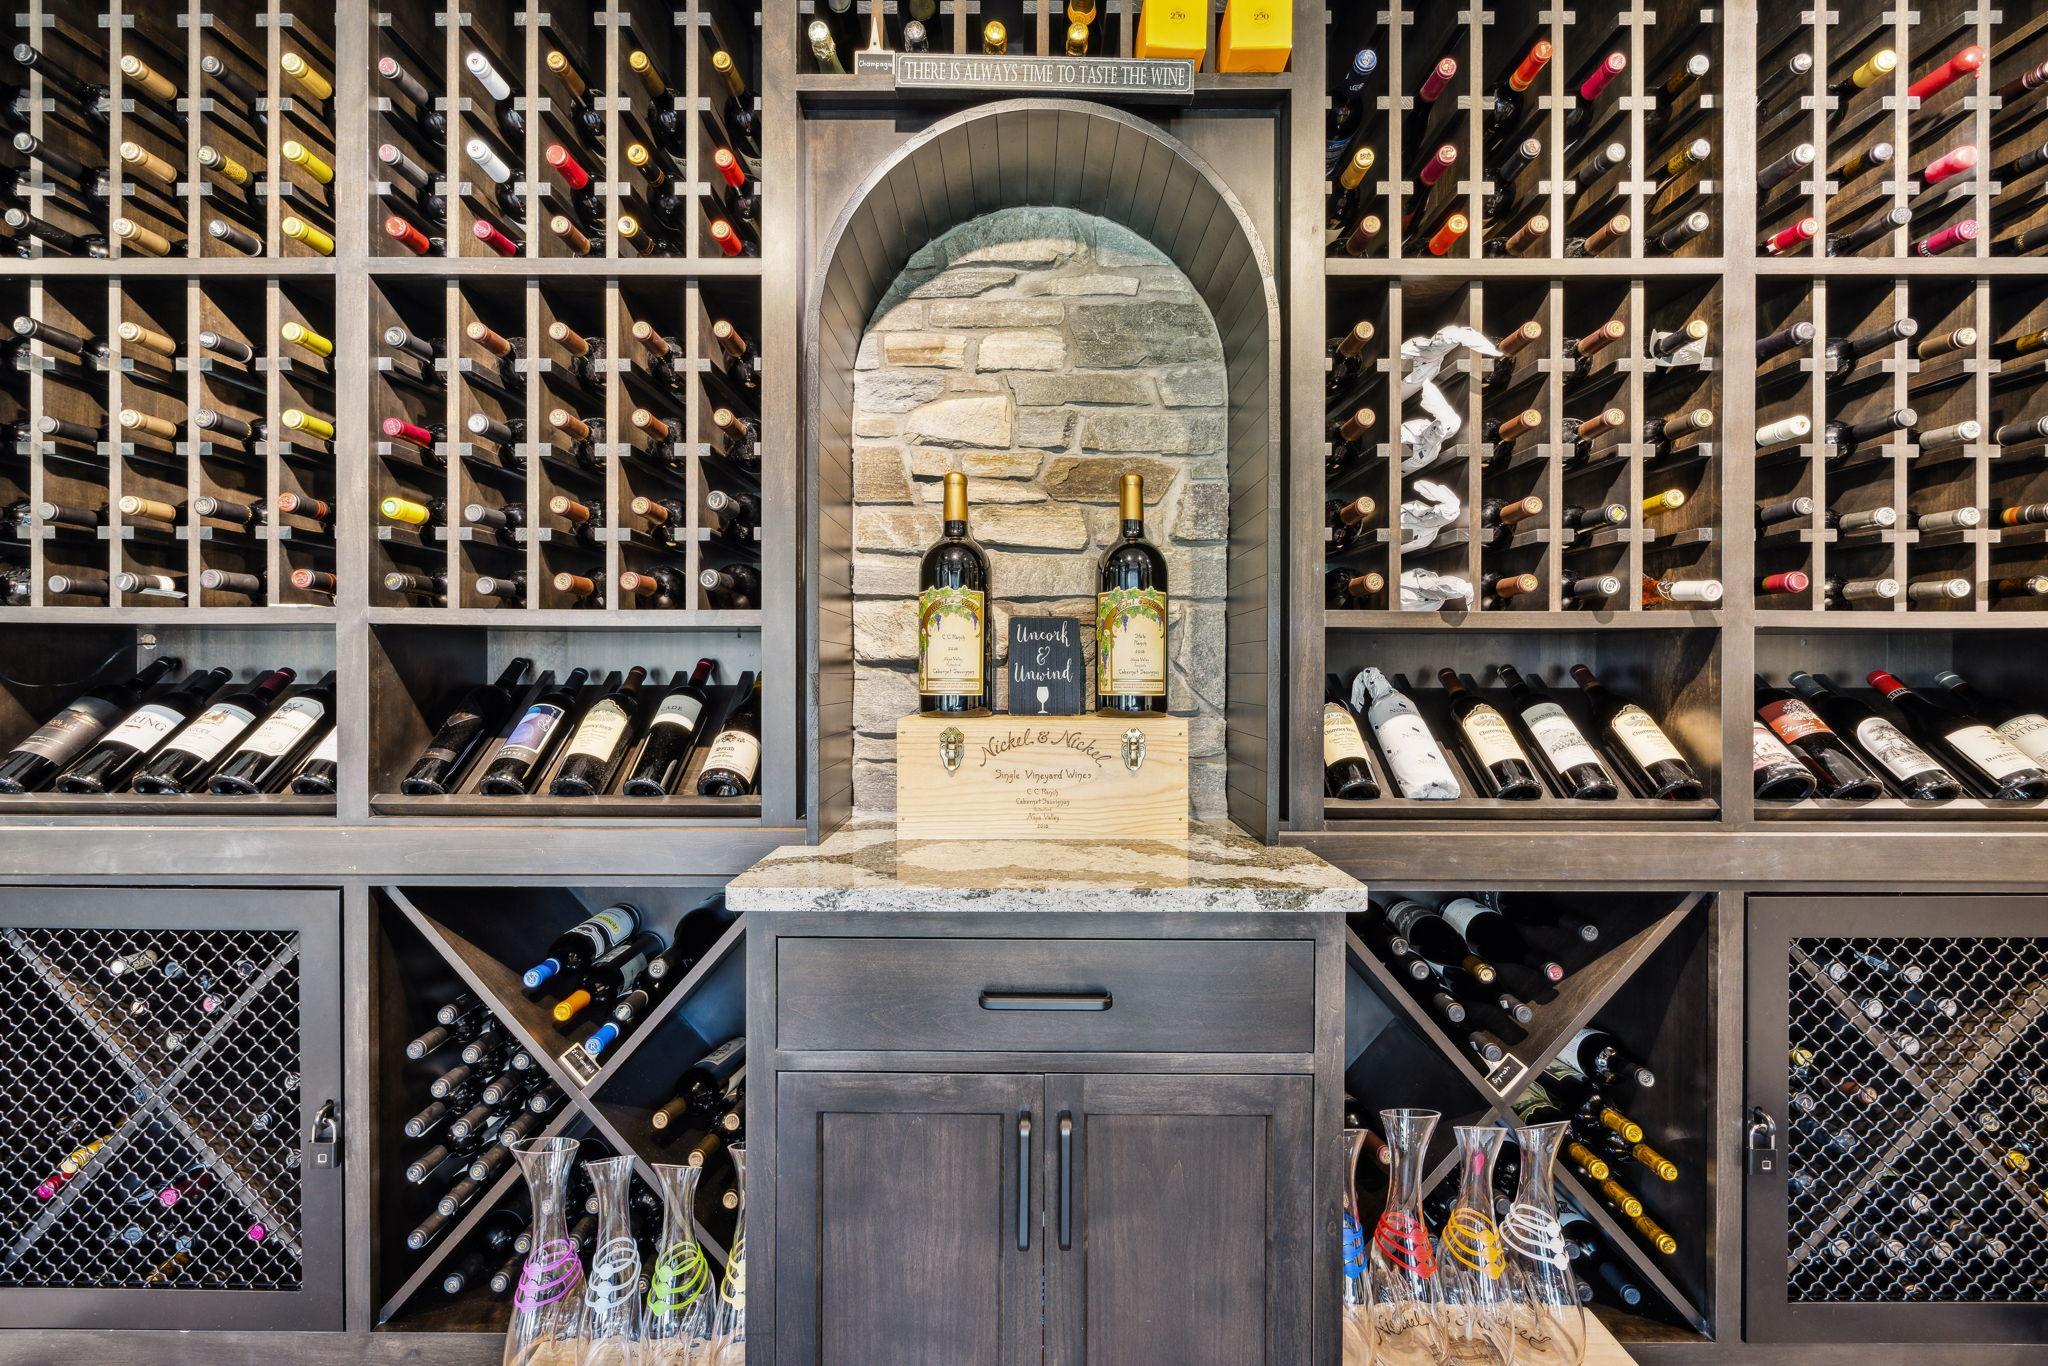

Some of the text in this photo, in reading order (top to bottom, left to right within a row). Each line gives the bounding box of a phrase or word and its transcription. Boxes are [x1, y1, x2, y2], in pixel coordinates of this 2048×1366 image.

[905, 61, 1185, 86] THERE IS ALWAYS TIME TO TASTE THE WINE
[1016, 620, 1071, 647] Uncork
[1036, 645, 1051, 666] &
[1014, 658, 1074, 683] Unwind
[2001, 717, 2034, 735] RIDGE
[979, 728, 1112, 768] Nickel & Nickel
[995, 769, 1092, 784] Single Vineyard Wines
[1015, 797, 1041, 807] Cabernet
[1026, 788, 1032, 796] C
[1034, 788, 1039, 796] C
[571, 1049, 595, 1074] Zinfandel
[1491, 1066, 1511, 1084] Syrah
